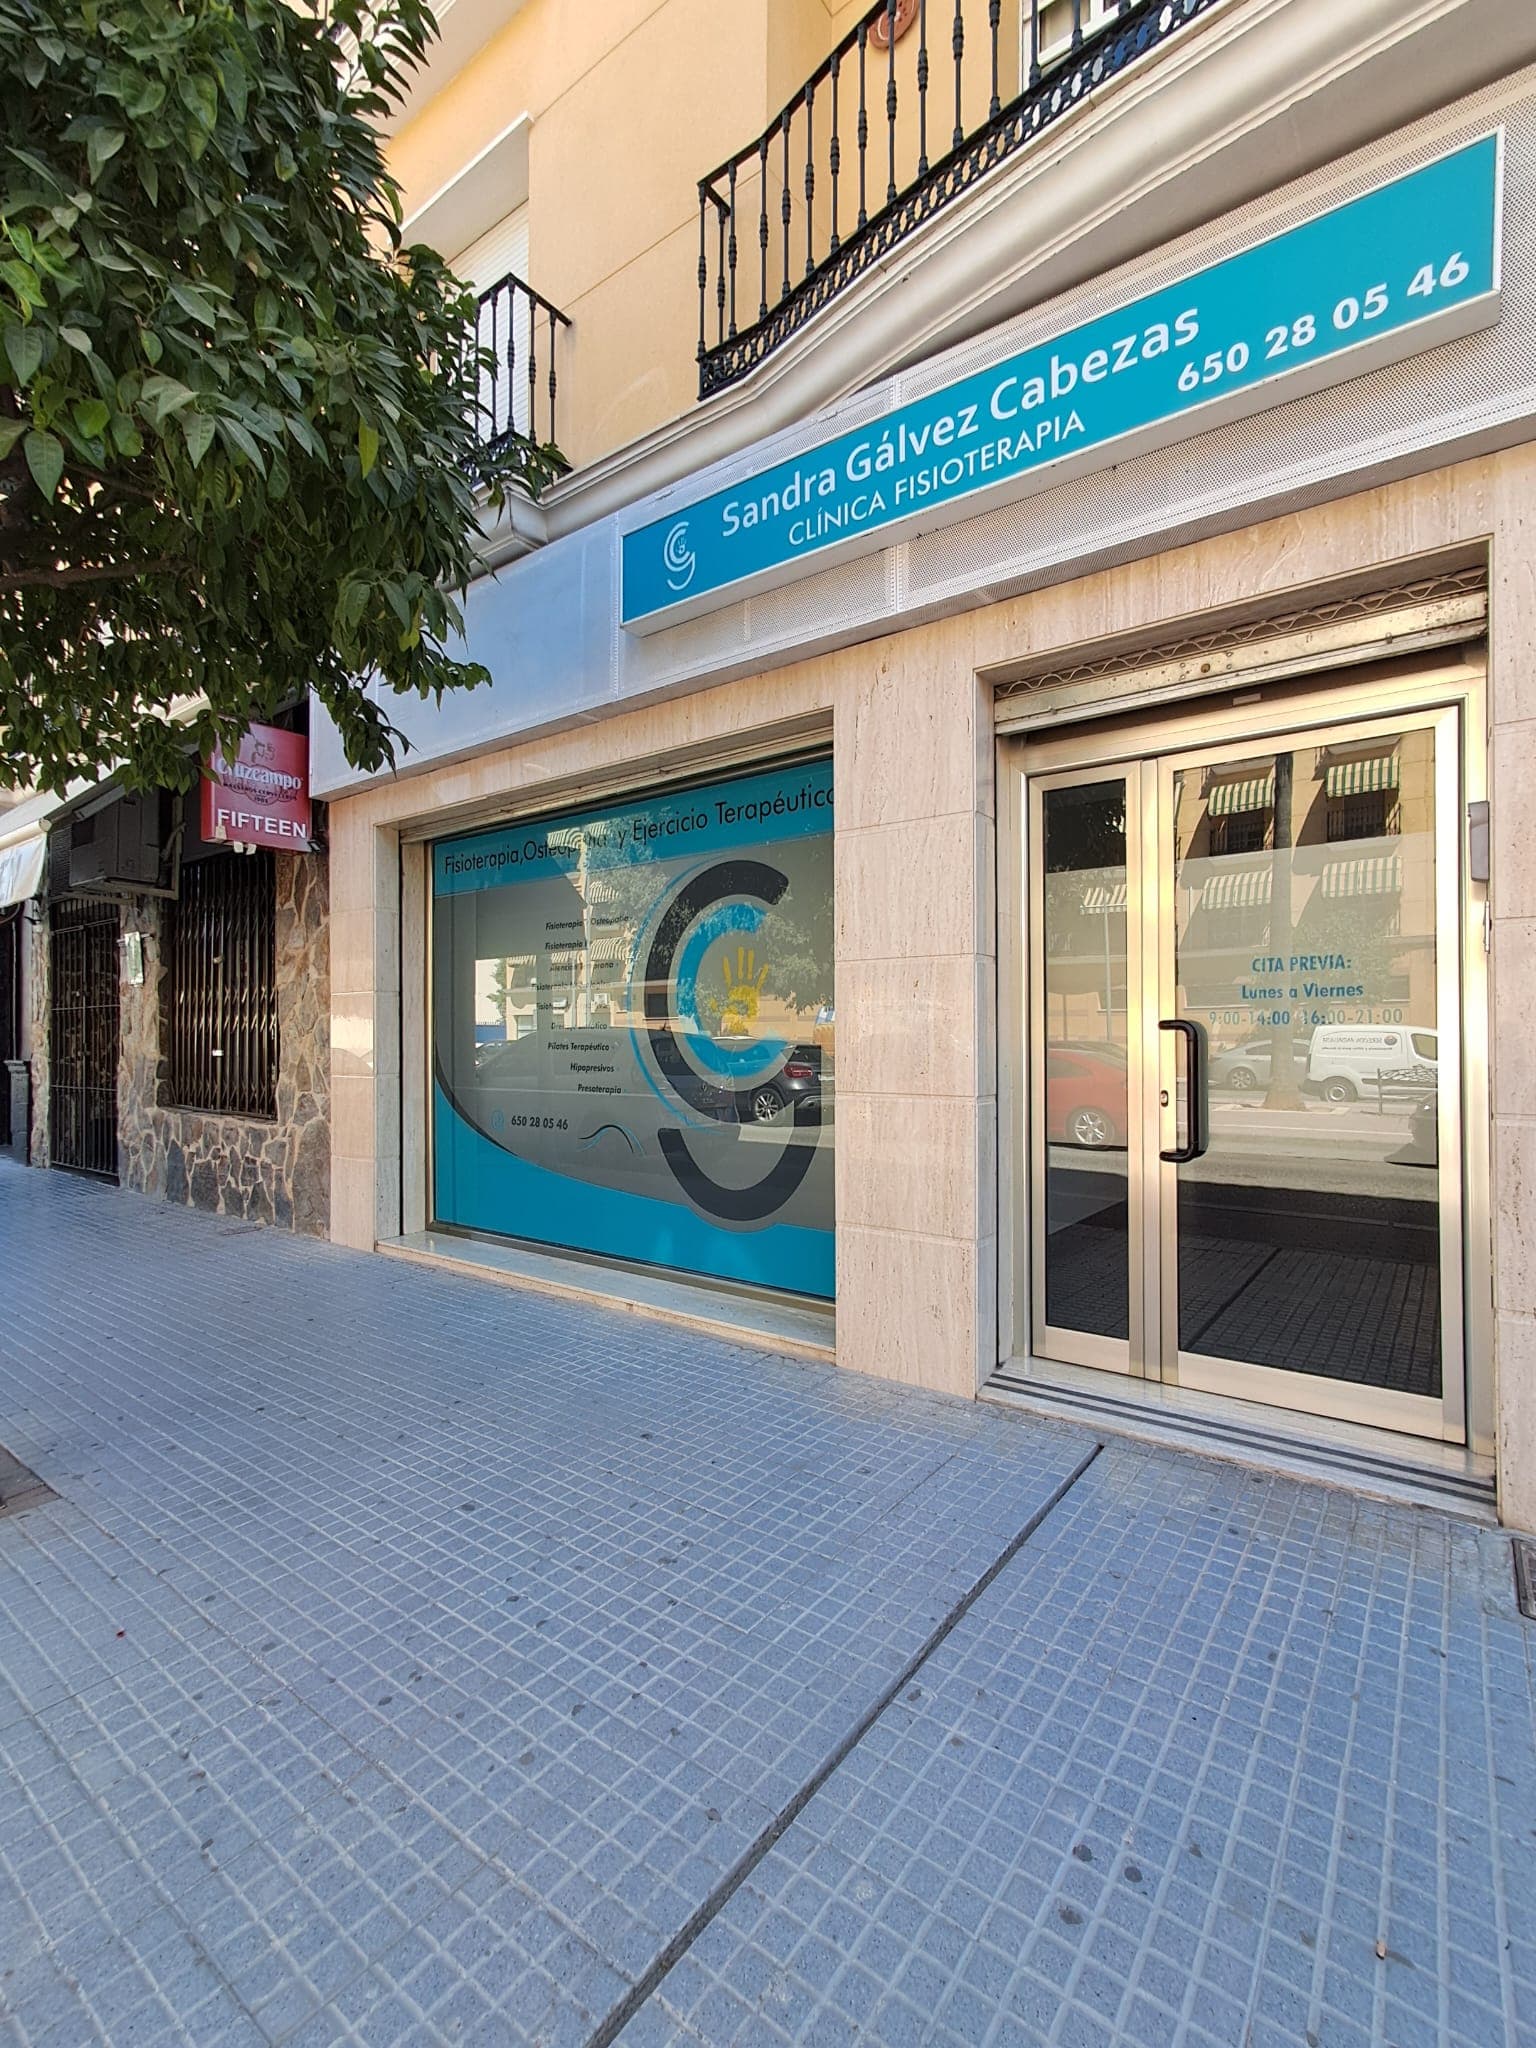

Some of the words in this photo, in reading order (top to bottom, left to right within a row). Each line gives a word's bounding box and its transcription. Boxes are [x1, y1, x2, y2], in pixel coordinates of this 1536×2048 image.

[1176, 342, 1251, 393] 650
[1264, 314, 1317, 361] 28
[1332, 283, 1390, 331] 05
[1406, 252, 1470, 298] 46
[721, 467, 837, 537] Sandra
[845, 404, 980, 482] Gálvez
[989, 307, 1201, 420] Cabezas
[788, 491, 887, 546] CLÍNICA
[893, 409, 1087, 507] FISIOTERAPIA
[217, 808, 307, 839] FIFTEEN
[616, 829, 628, 850] y
[633, 807, 709, 846] Ejercicio
[545, 920, 583, 931] Fisioterapia
[1251, 956, 1284, 973] CITA
[1289, 954, 1353, 972] PREVIA:
[1240, 984, 1284, 1000] Lunes
[1288, 987, 1298, 999] a
[1303, 982, 1365, 998] Viernes
[547, 1041, 569, 1051] Pilates
[570, 1041, 610, 1053] Terapéutico
[577, 1083, 622, 1096] Presoterapia
[511, 1114, 528, 1127] 650
[529, 1116, 540, 1128] 28
[542, 1117, 554, 1129] 05
[556, 1118, 569, 1131] 46
